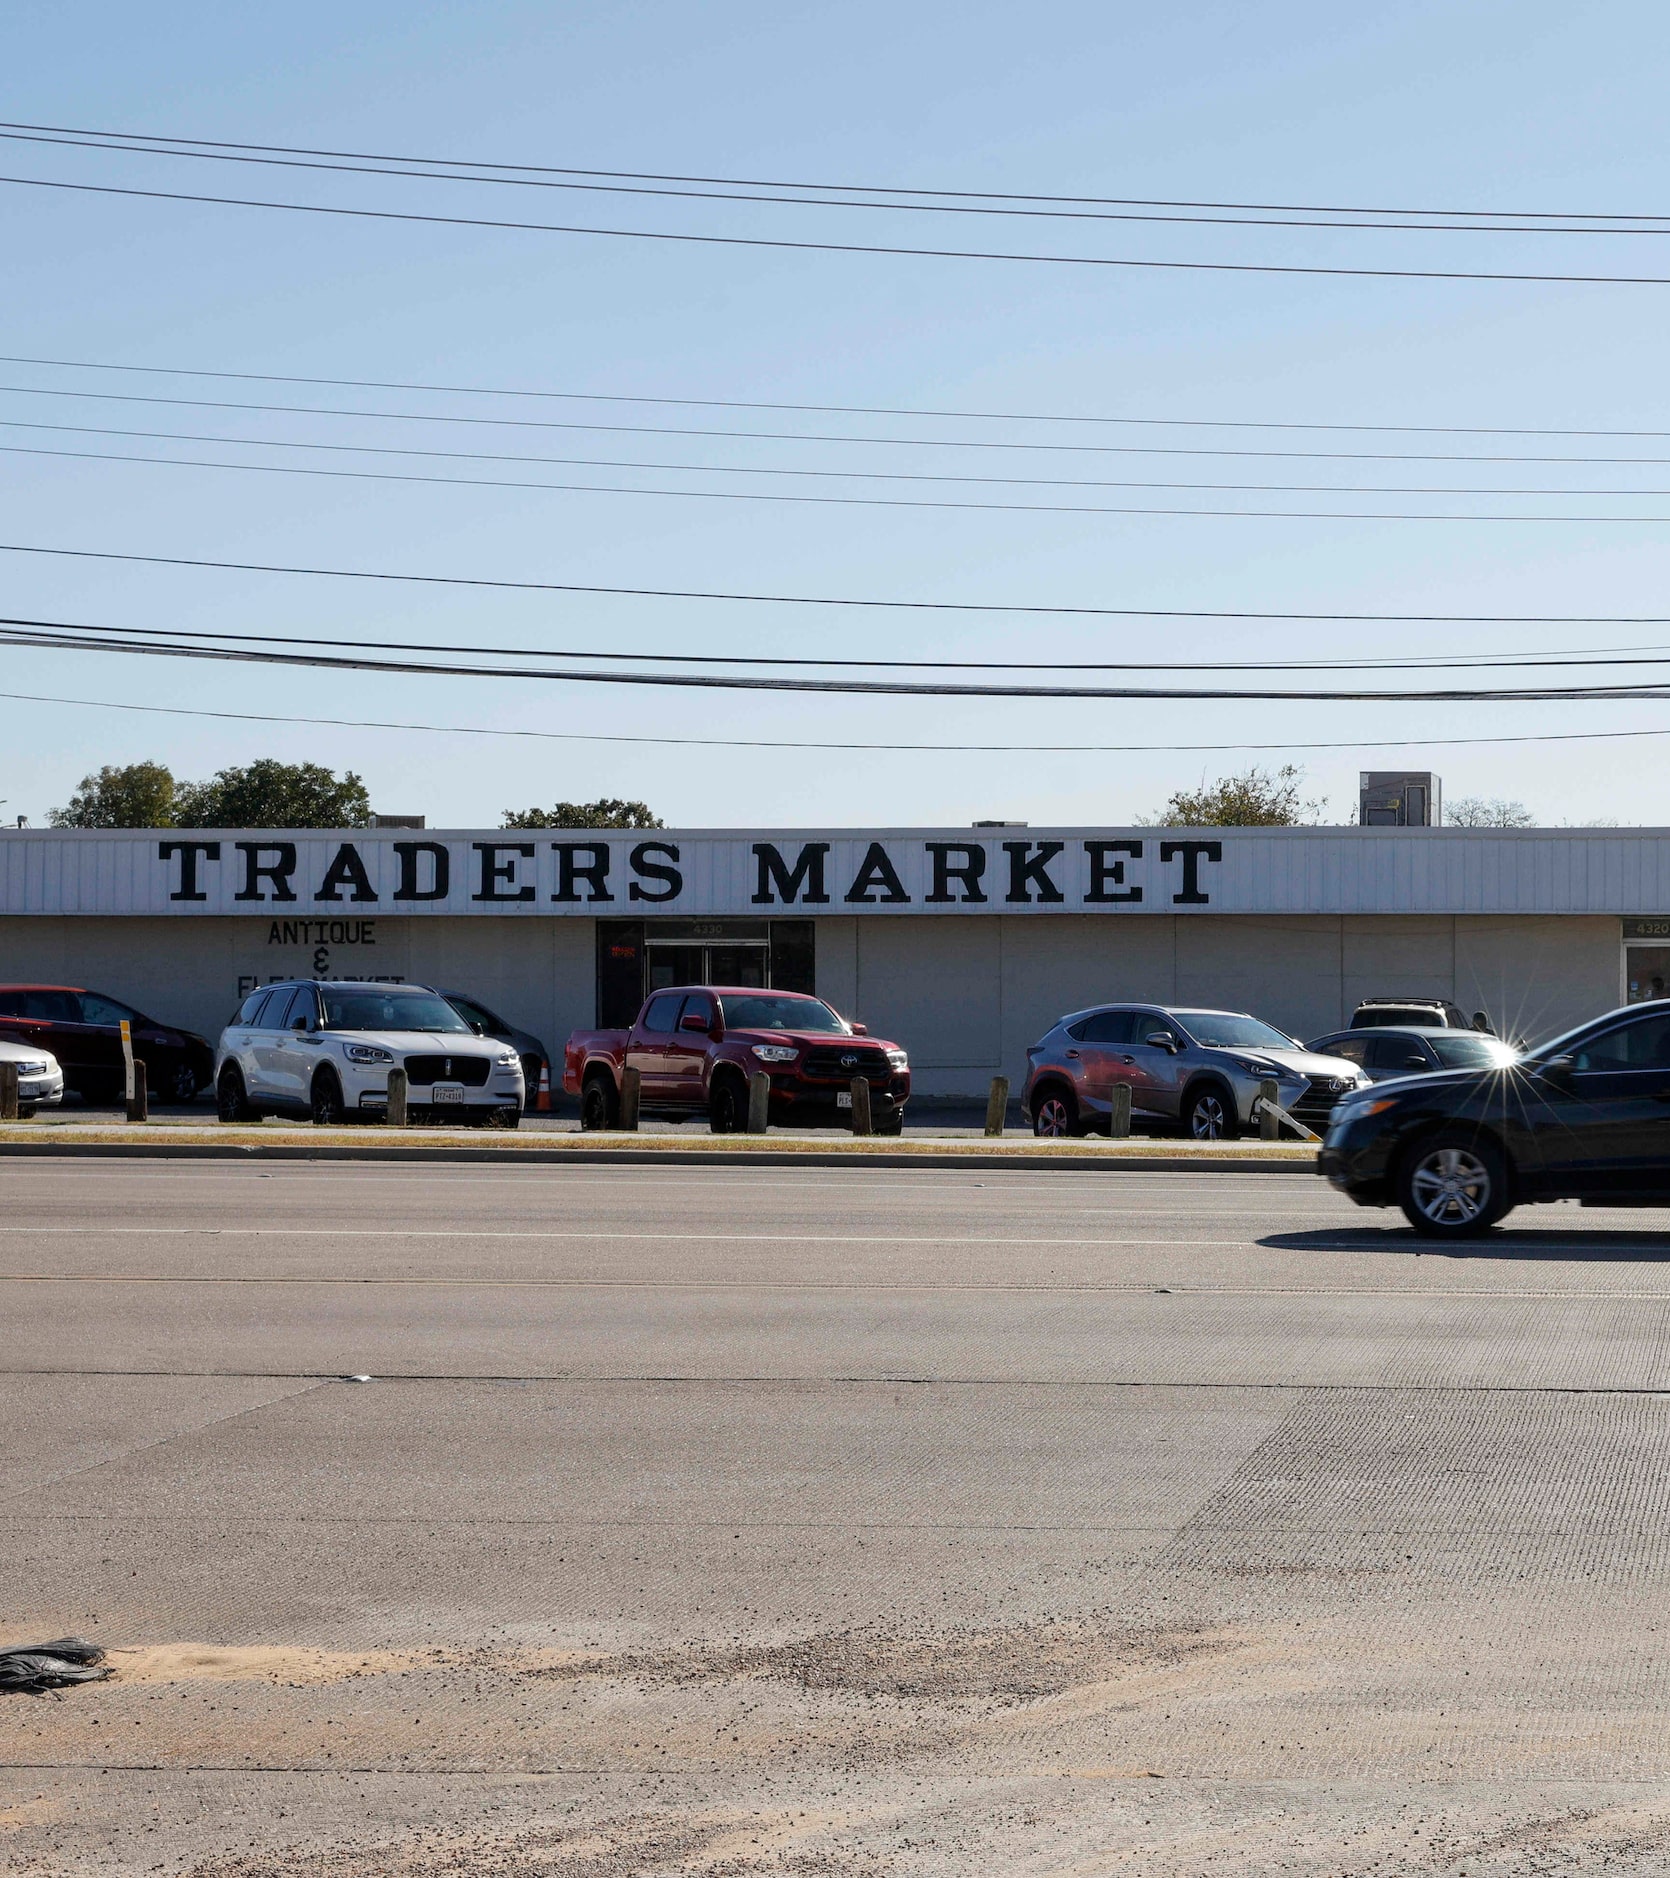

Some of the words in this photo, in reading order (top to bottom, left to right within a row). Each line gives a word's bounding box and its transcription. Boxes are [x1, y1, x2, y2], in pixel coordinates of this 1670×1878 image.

[159, 841, 683, 903] TRADERS
[752, 841, 1222, 903] MARKET
[268, 921, 375, 944] ANTIQUE
[693, 924, 722, 934] 4330
[1636, 923, 1670, 934] 4320
[313, 947, 329, 974] &
